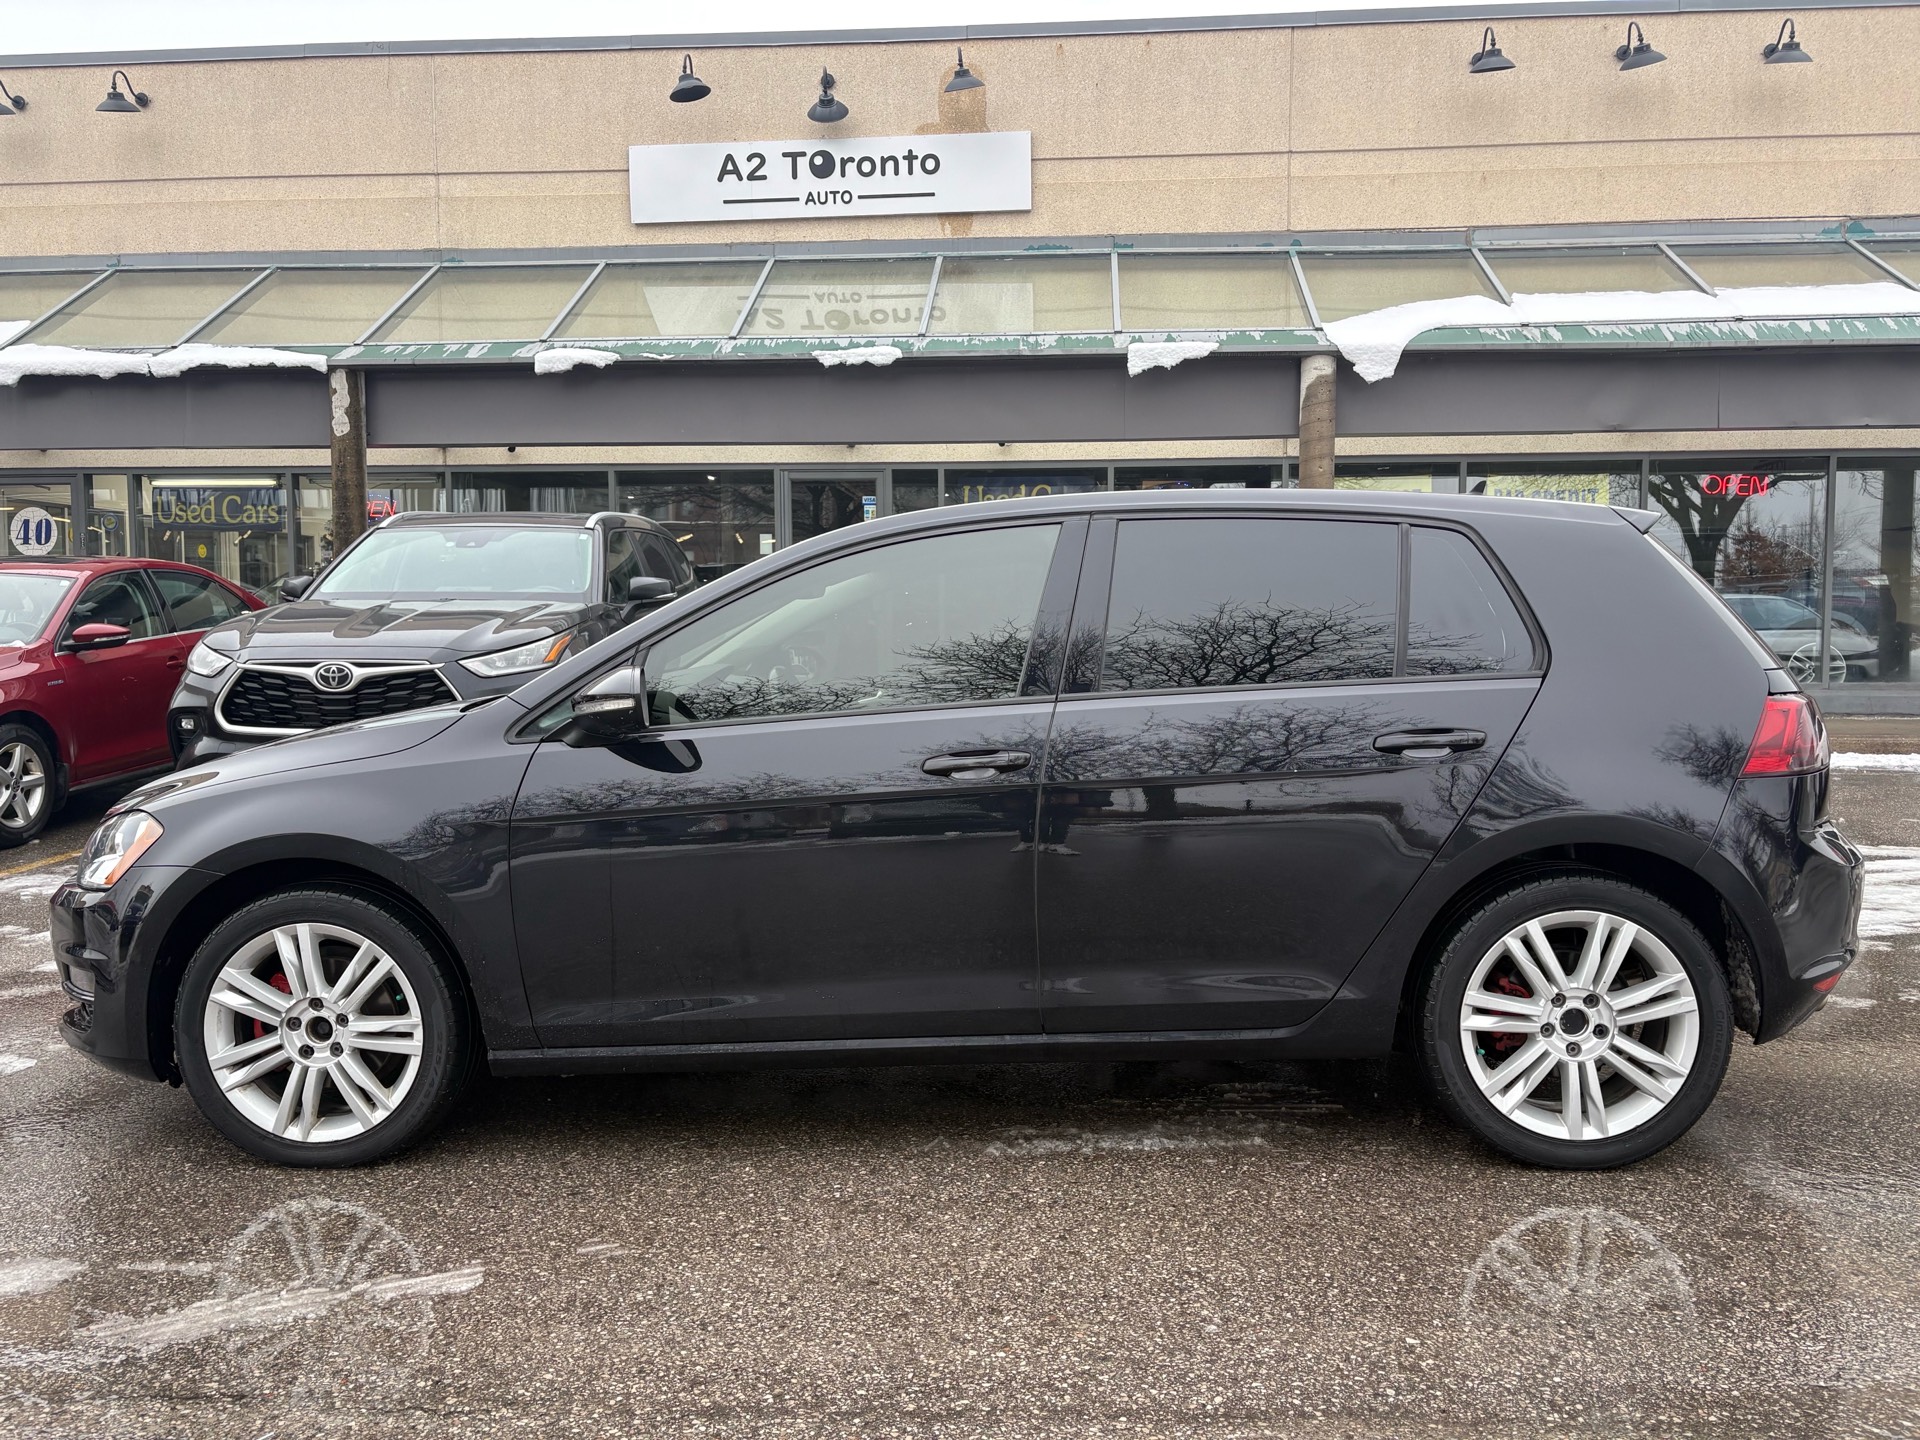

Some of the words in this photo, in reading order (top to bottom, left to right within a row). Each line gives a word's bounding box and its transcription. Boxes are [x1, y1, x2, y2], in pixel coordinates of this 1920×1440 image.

[717, 152, 768, 183] A2
[804, 190, 853, 206] AUTO
[1702, 474, 1769, 497] OPEN
[156, 495, 217, 524] Used
[222, 495, 280, 524] Cars
[15, 518, 52, 546] 40
